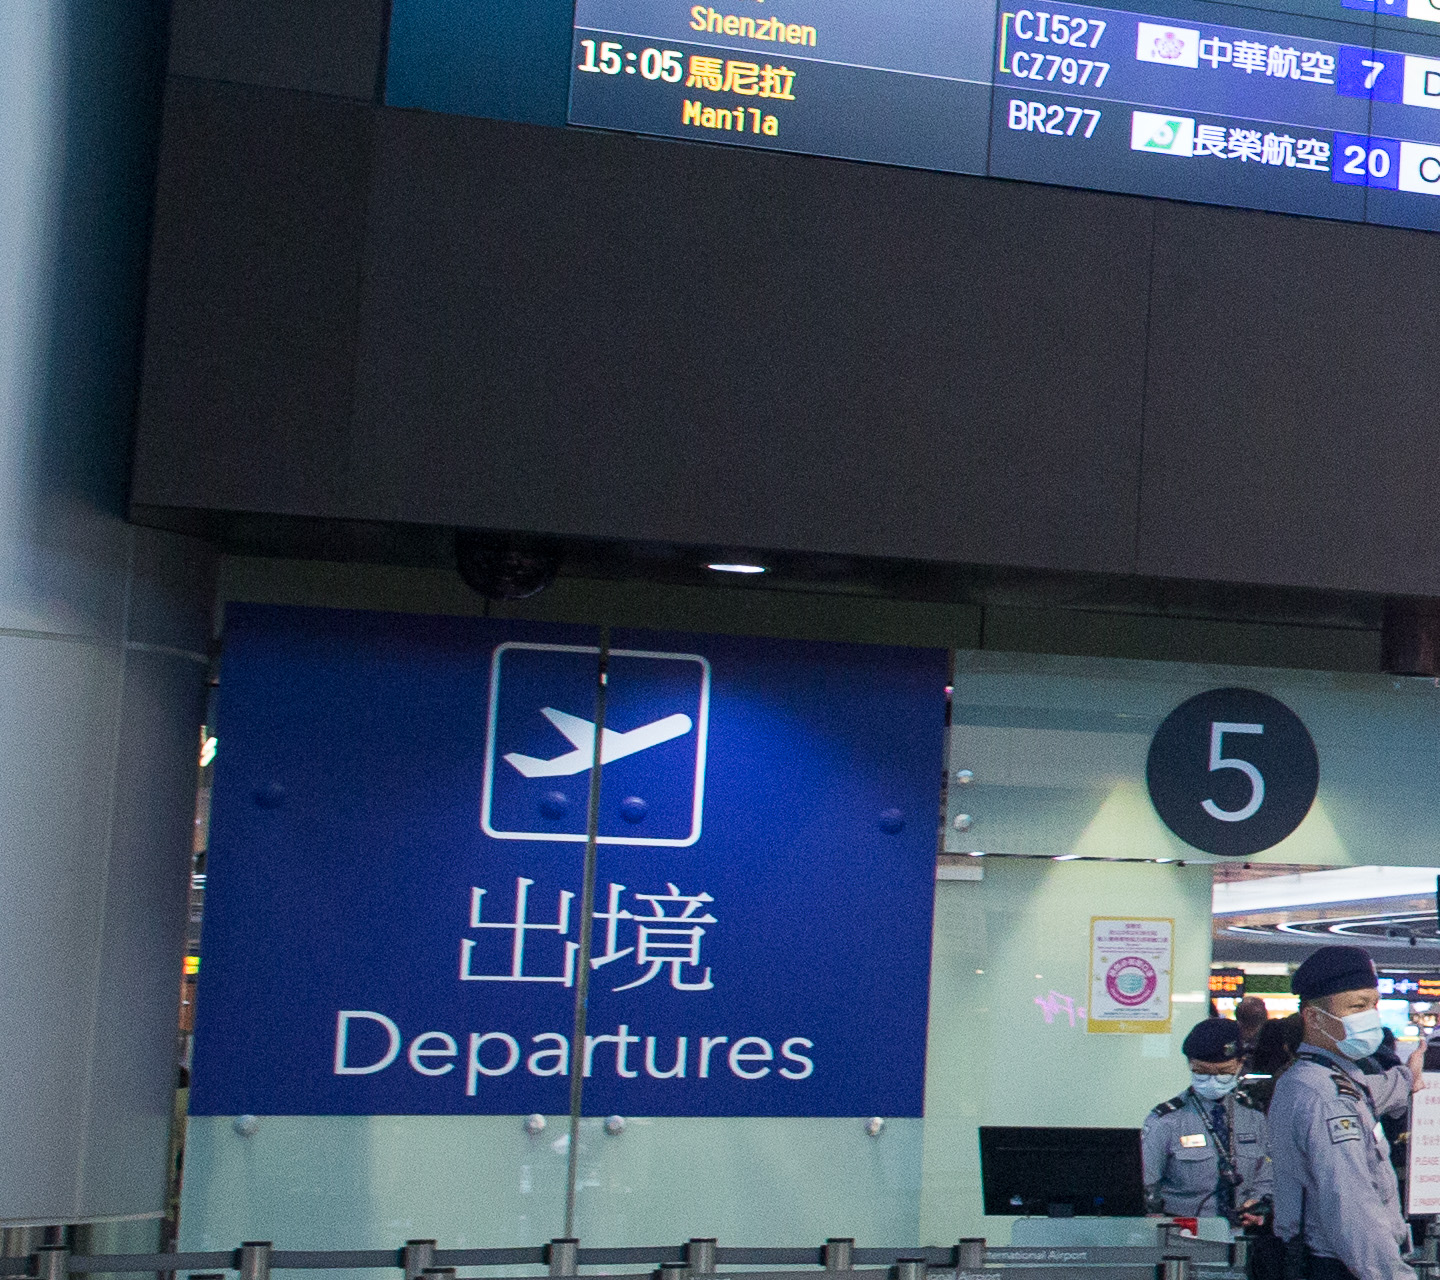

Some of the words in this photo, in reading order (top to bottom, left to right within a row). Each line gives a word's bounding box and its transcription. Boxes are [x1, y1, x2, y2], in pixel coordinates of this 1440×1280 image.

[690, 5, 817, 48] Shenzhen
[579, 39, 682, 84] 15:05
[684, 55, 796, 103] 馬尼拉
[682, 99, 779, 138] Manila
[1009, 100, 1101, 140] BR277
[1201, 722, 1264, 822] 5
[460, 878, 716, 995] 出境
[333, 1010, 815, 1096] Departures
